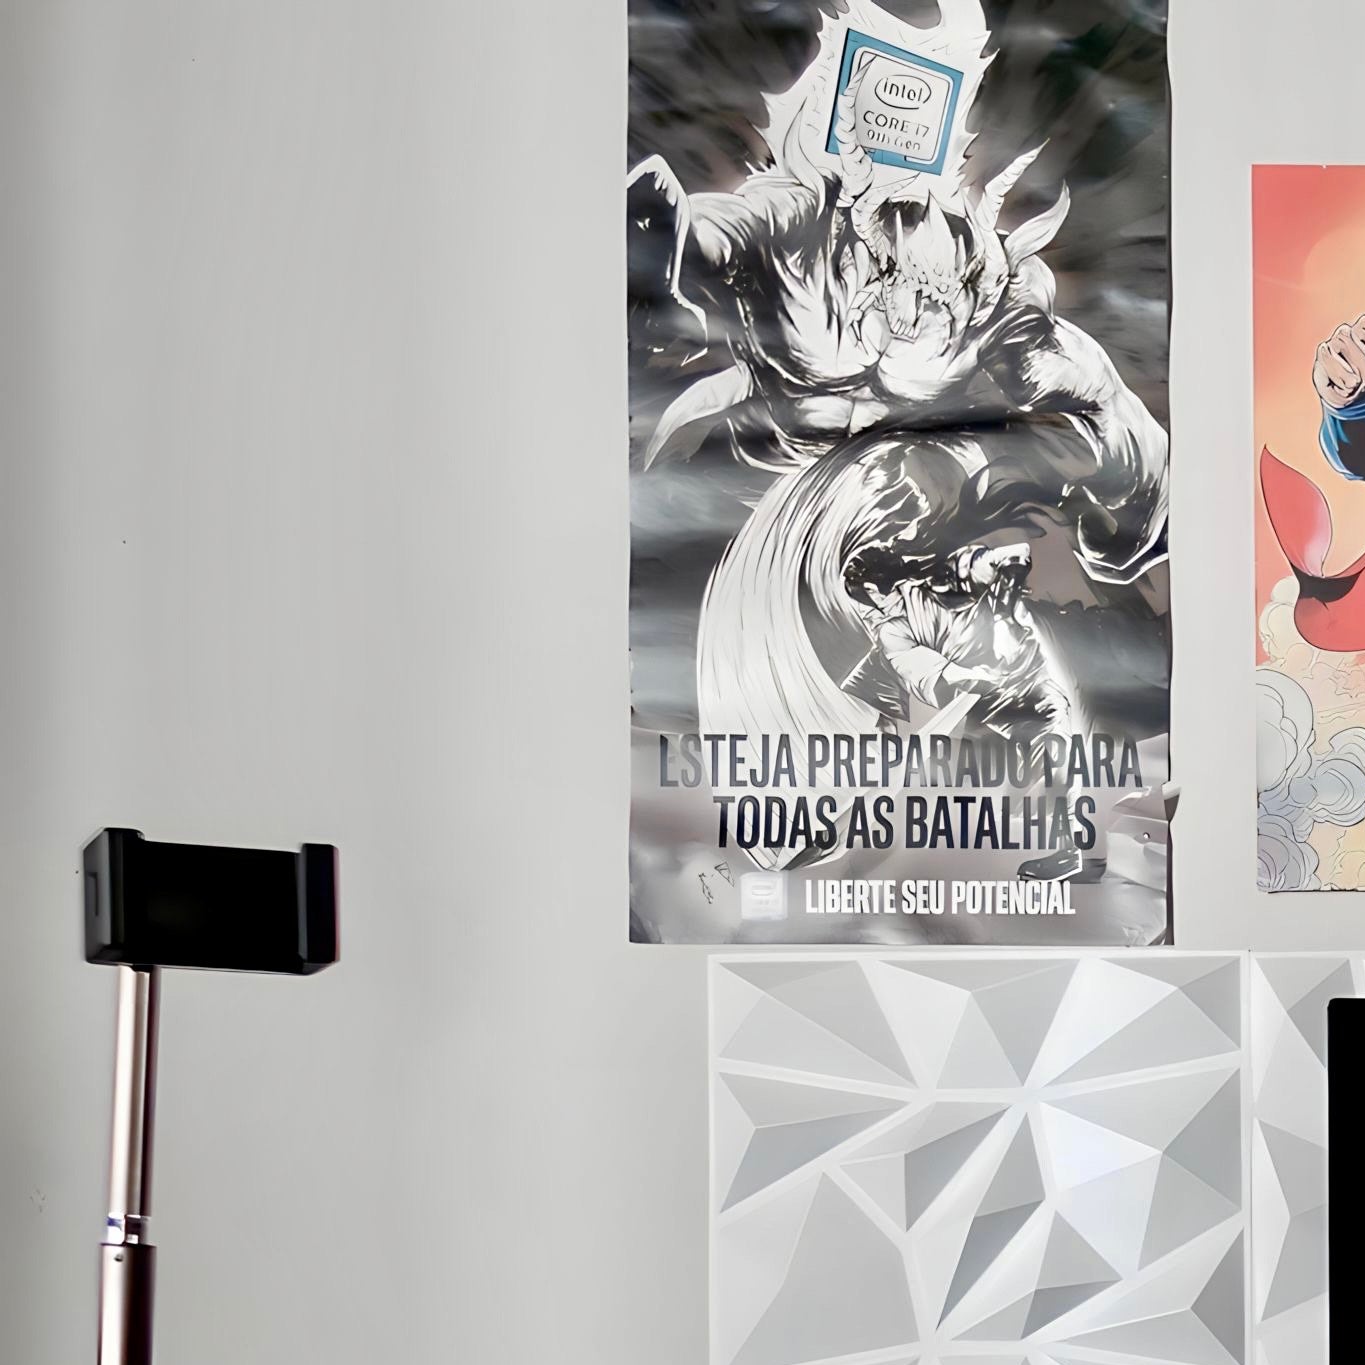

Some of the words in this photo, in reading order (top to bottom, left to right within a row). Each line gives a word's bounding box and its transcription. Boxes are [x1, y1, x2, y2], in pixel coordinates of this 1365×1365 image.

[883, 77, 923, 102] intel
[863, 110, 909, 133] CORE
[807, 733, 1032, 788] PREPARADO
[1043, 733, 1143, 788] PARA
[713, 795, 837, 849] TODAS
[846, 795, 894, 849] AS
[905, 795, 1096, 850] BATALHAS
[805, 879, 897, 914] LIBERTE
[902, 880, 945, 915] SEU
[952, 880, 1076, 915] POTENCIAL
